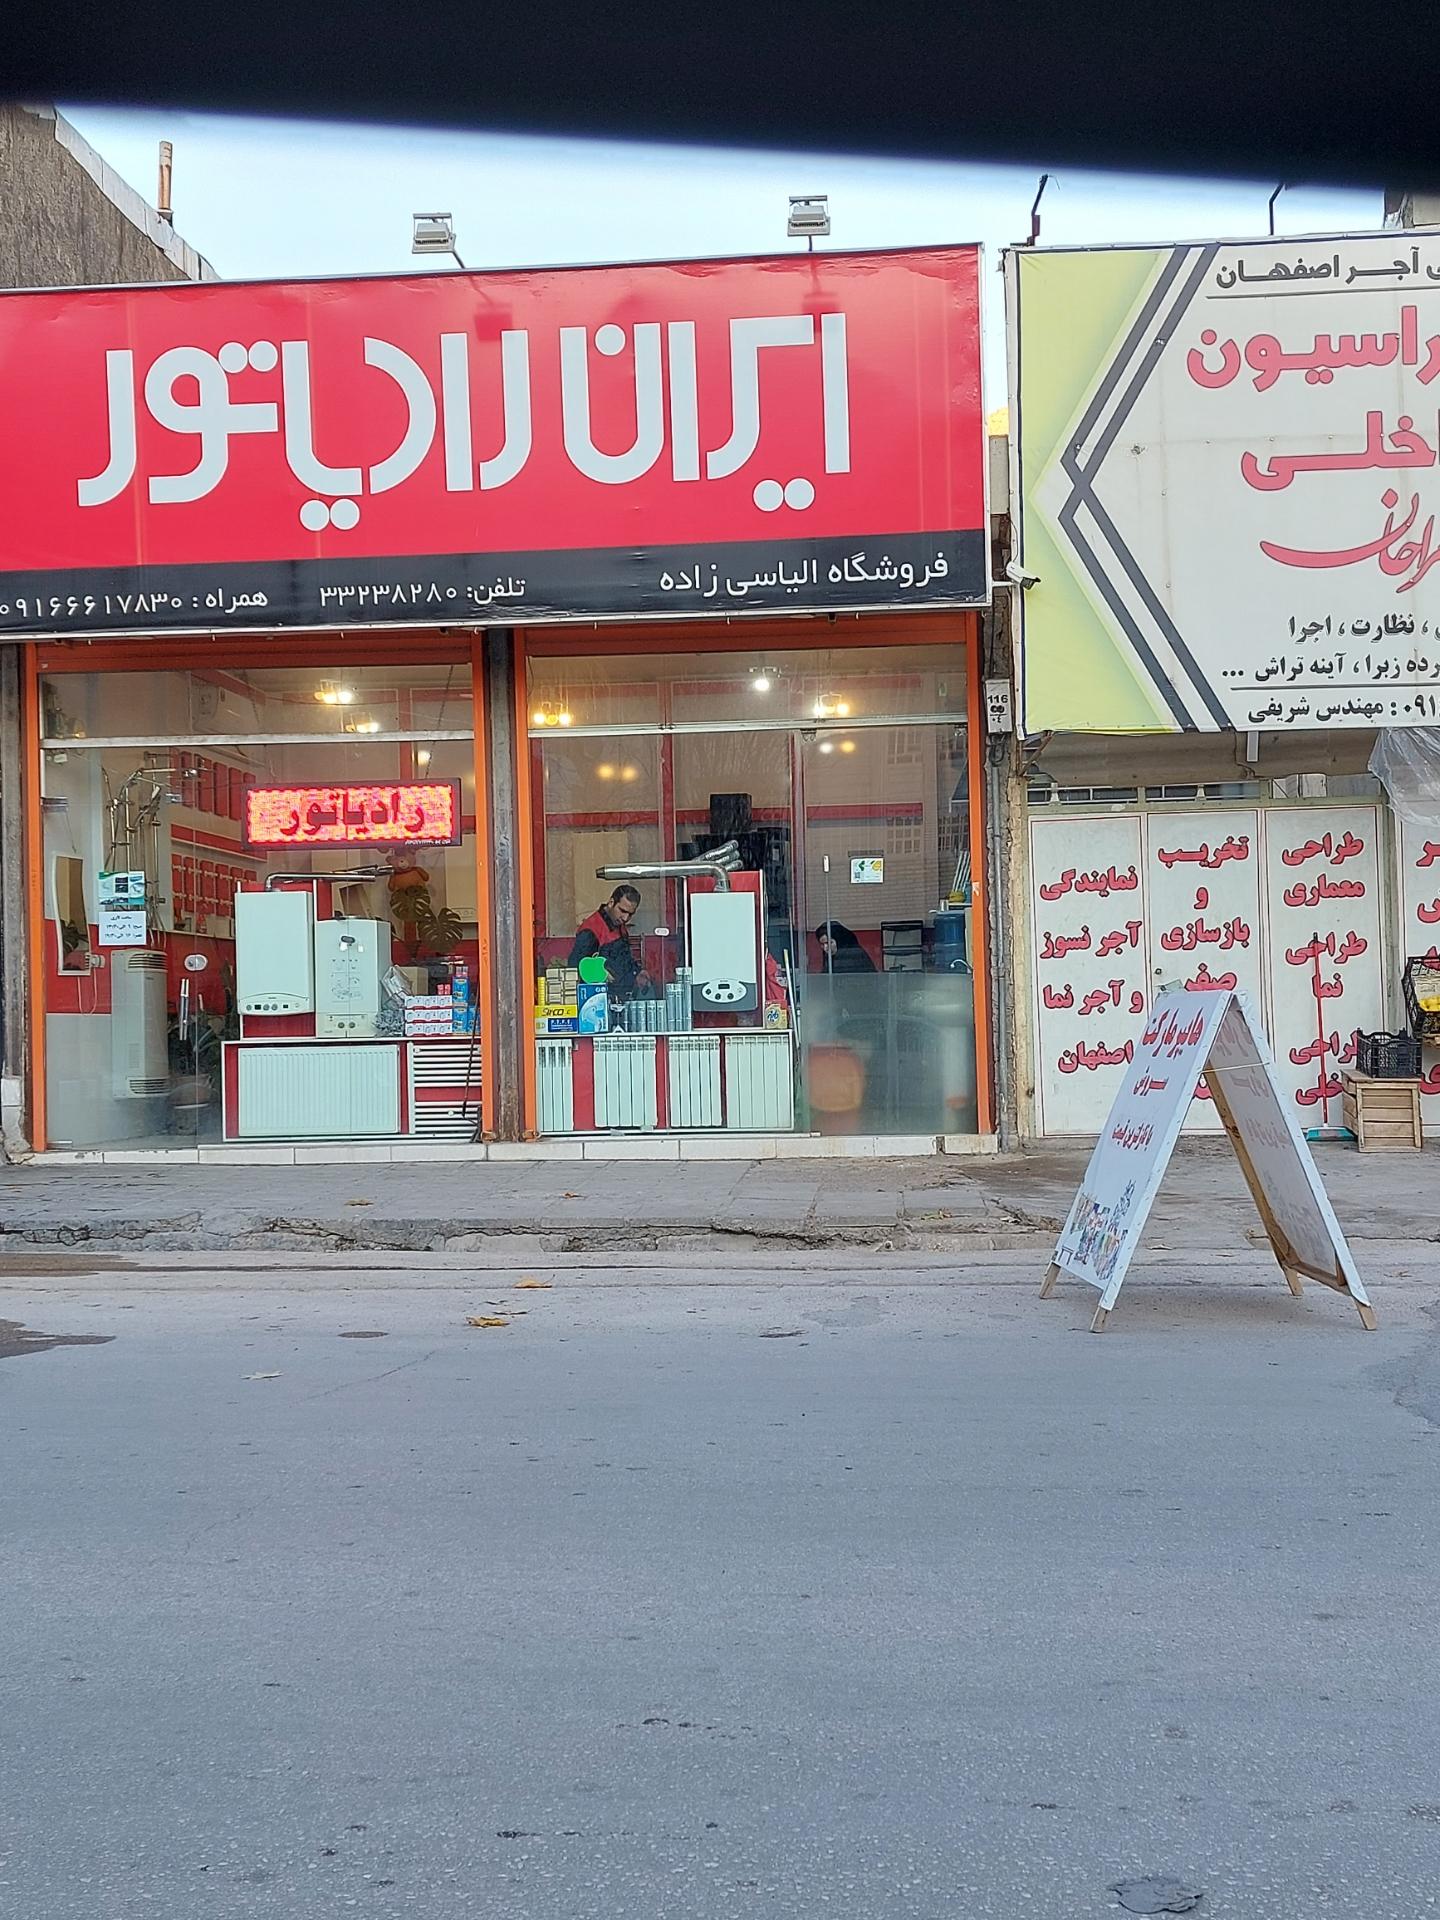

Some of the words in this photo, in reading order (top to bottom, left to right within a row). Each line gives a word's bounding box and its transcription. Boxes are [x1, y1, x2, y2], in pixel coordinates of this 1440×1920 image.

[1216, 254, 1339, 288] اصفهان
[559, 312, 851, 512] ایران
[77, 328, 532, 532] رادیاتور
[1241, 410, 1440, 491] خلی
[659, 563, 719, 598] زاده
[726, 559, 818, 597] الیاسی
[827, 551, 950, 588] فروشگاه
[319, 582, 458, 607] ۳۳۲۳۸۲۸۰
[1288, 615, 1332, 644] اجرا
[1255, 656, 1304, 682] تراش
[1309, 653, 1347, 680] آینه
[1248, 696, 1311, 724] شریفی
[1316, 699, 1384, 723] مهندس
[1158, 836, 1250, 869] تخریب
[1281, 831, 1364, 867] طراحی
[1039, 865, 1139, 901] نمایندگی
[1194, 886, 1209, 910] و
[1283, 873, 1366, 907] معماری
[1039, 924, 1092, 959] نسوز
[1095, 920, 1143, 957] آجر
[1285, 930, 1368, 966] طراحی
[1042, 984, 1075, 1010] نما
[1078, 979, 1125, 1016] آجر
[1129, 990, 1144, 1014] و
[1312, 972, 1344, 999] نما
[1058, 1039, 1135, 1074] اصفهان
